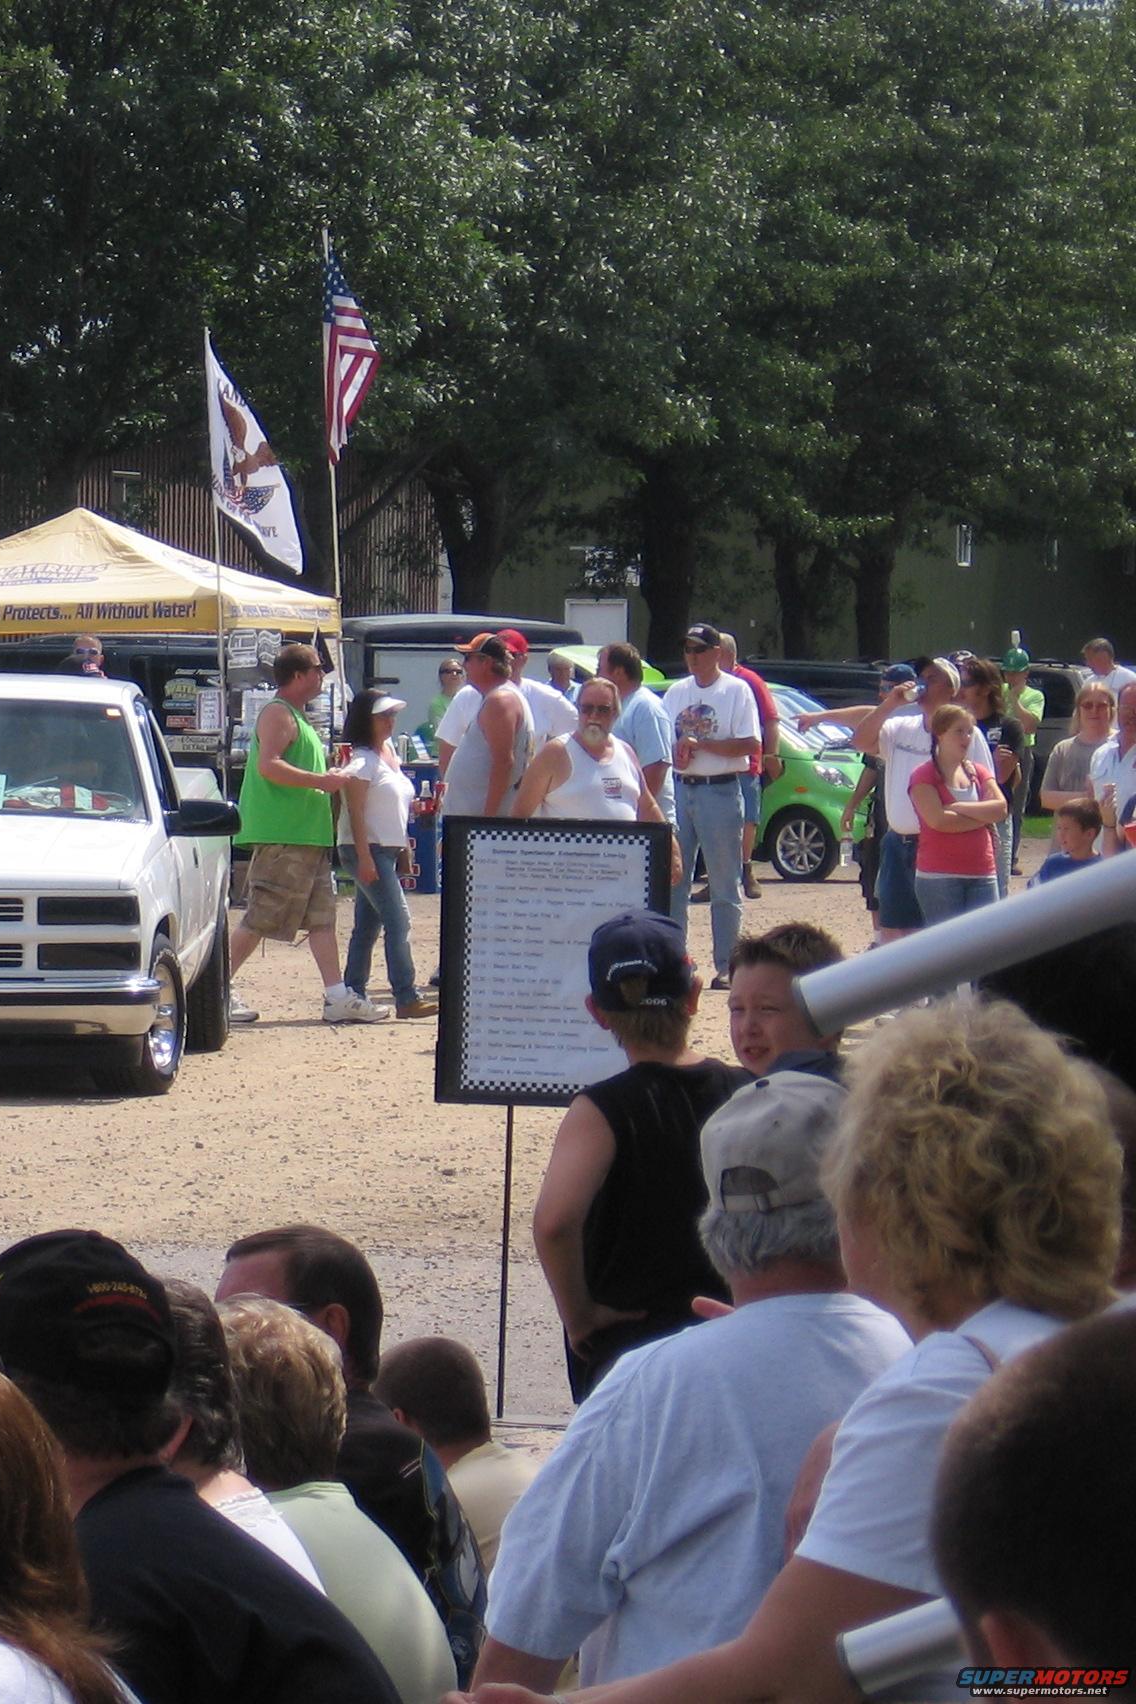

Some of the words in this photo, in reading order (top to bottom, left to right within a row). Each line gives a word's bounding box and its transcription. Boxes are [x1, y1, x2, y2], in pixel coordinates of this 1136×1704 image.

[75, 602, 94, 619] All
[95, 601, 149, 620] Without
[152, 600, 197, 619] Water!
